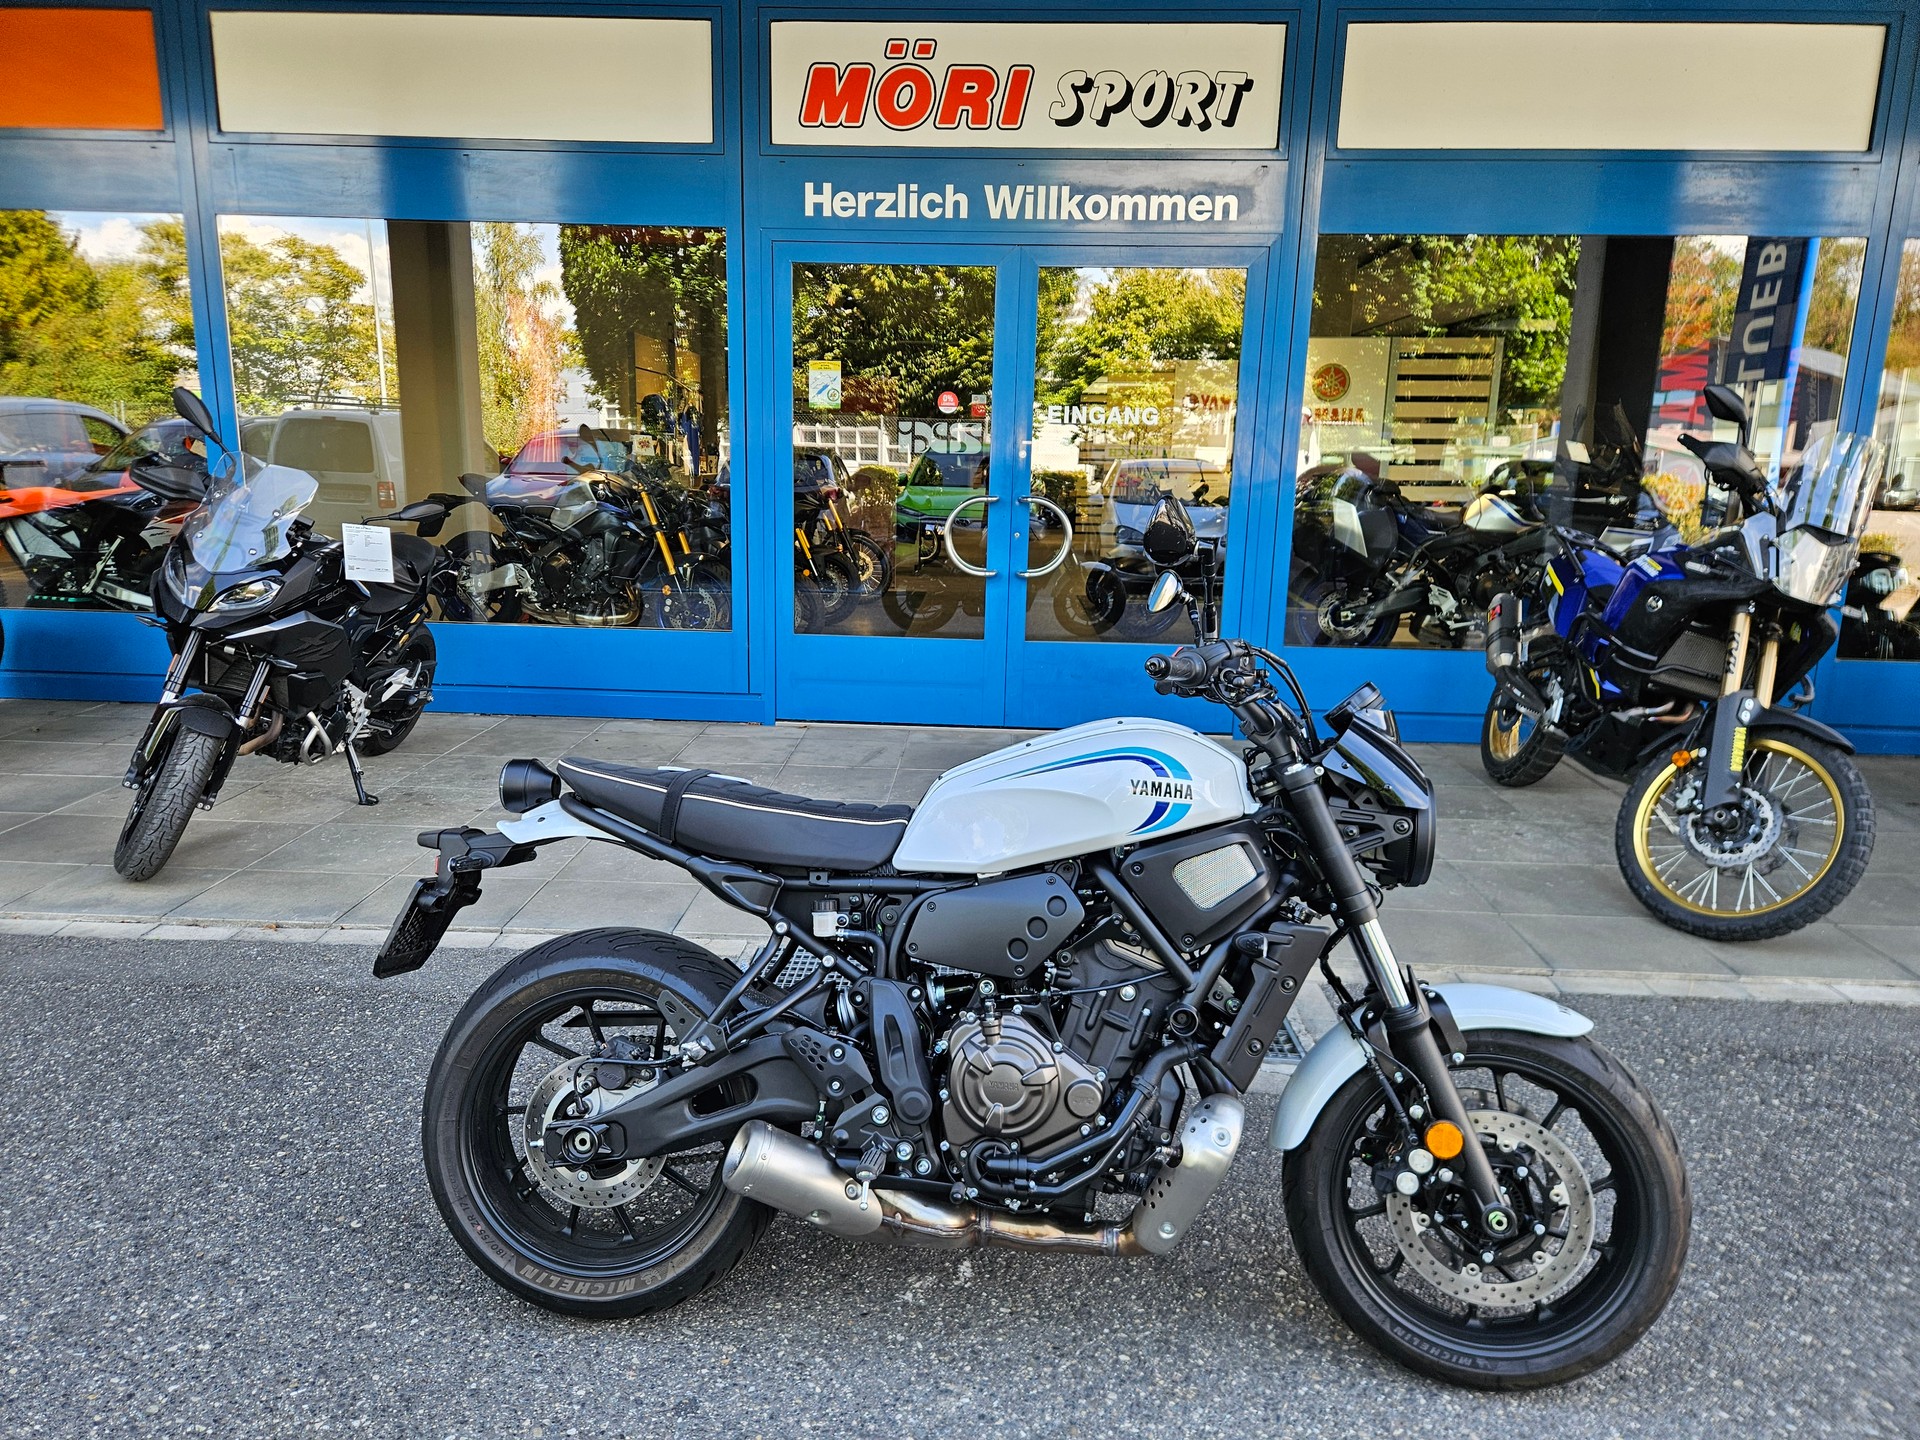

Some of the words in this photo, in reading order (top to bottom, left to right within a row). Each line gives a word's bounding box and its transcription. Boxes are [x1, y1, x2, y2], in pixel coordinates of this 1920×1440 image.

[799, 37, 1035, 131] MÖRI
[1048, 69, 1254, 131] SPORT
[804, 182, 968, 219] Herzlich
[983, 183, 1239, 221] Willkommen
[1048, 405, 1159, 426] EINGANG
[1130, 779, 1193, 800] YAMAHA
[988, 1079, 1020, 1092] YAMAHA
[519, 1264, 636, 1296] MICHELIN
[1393, 1325, 1472, 1366] MICHELIN
